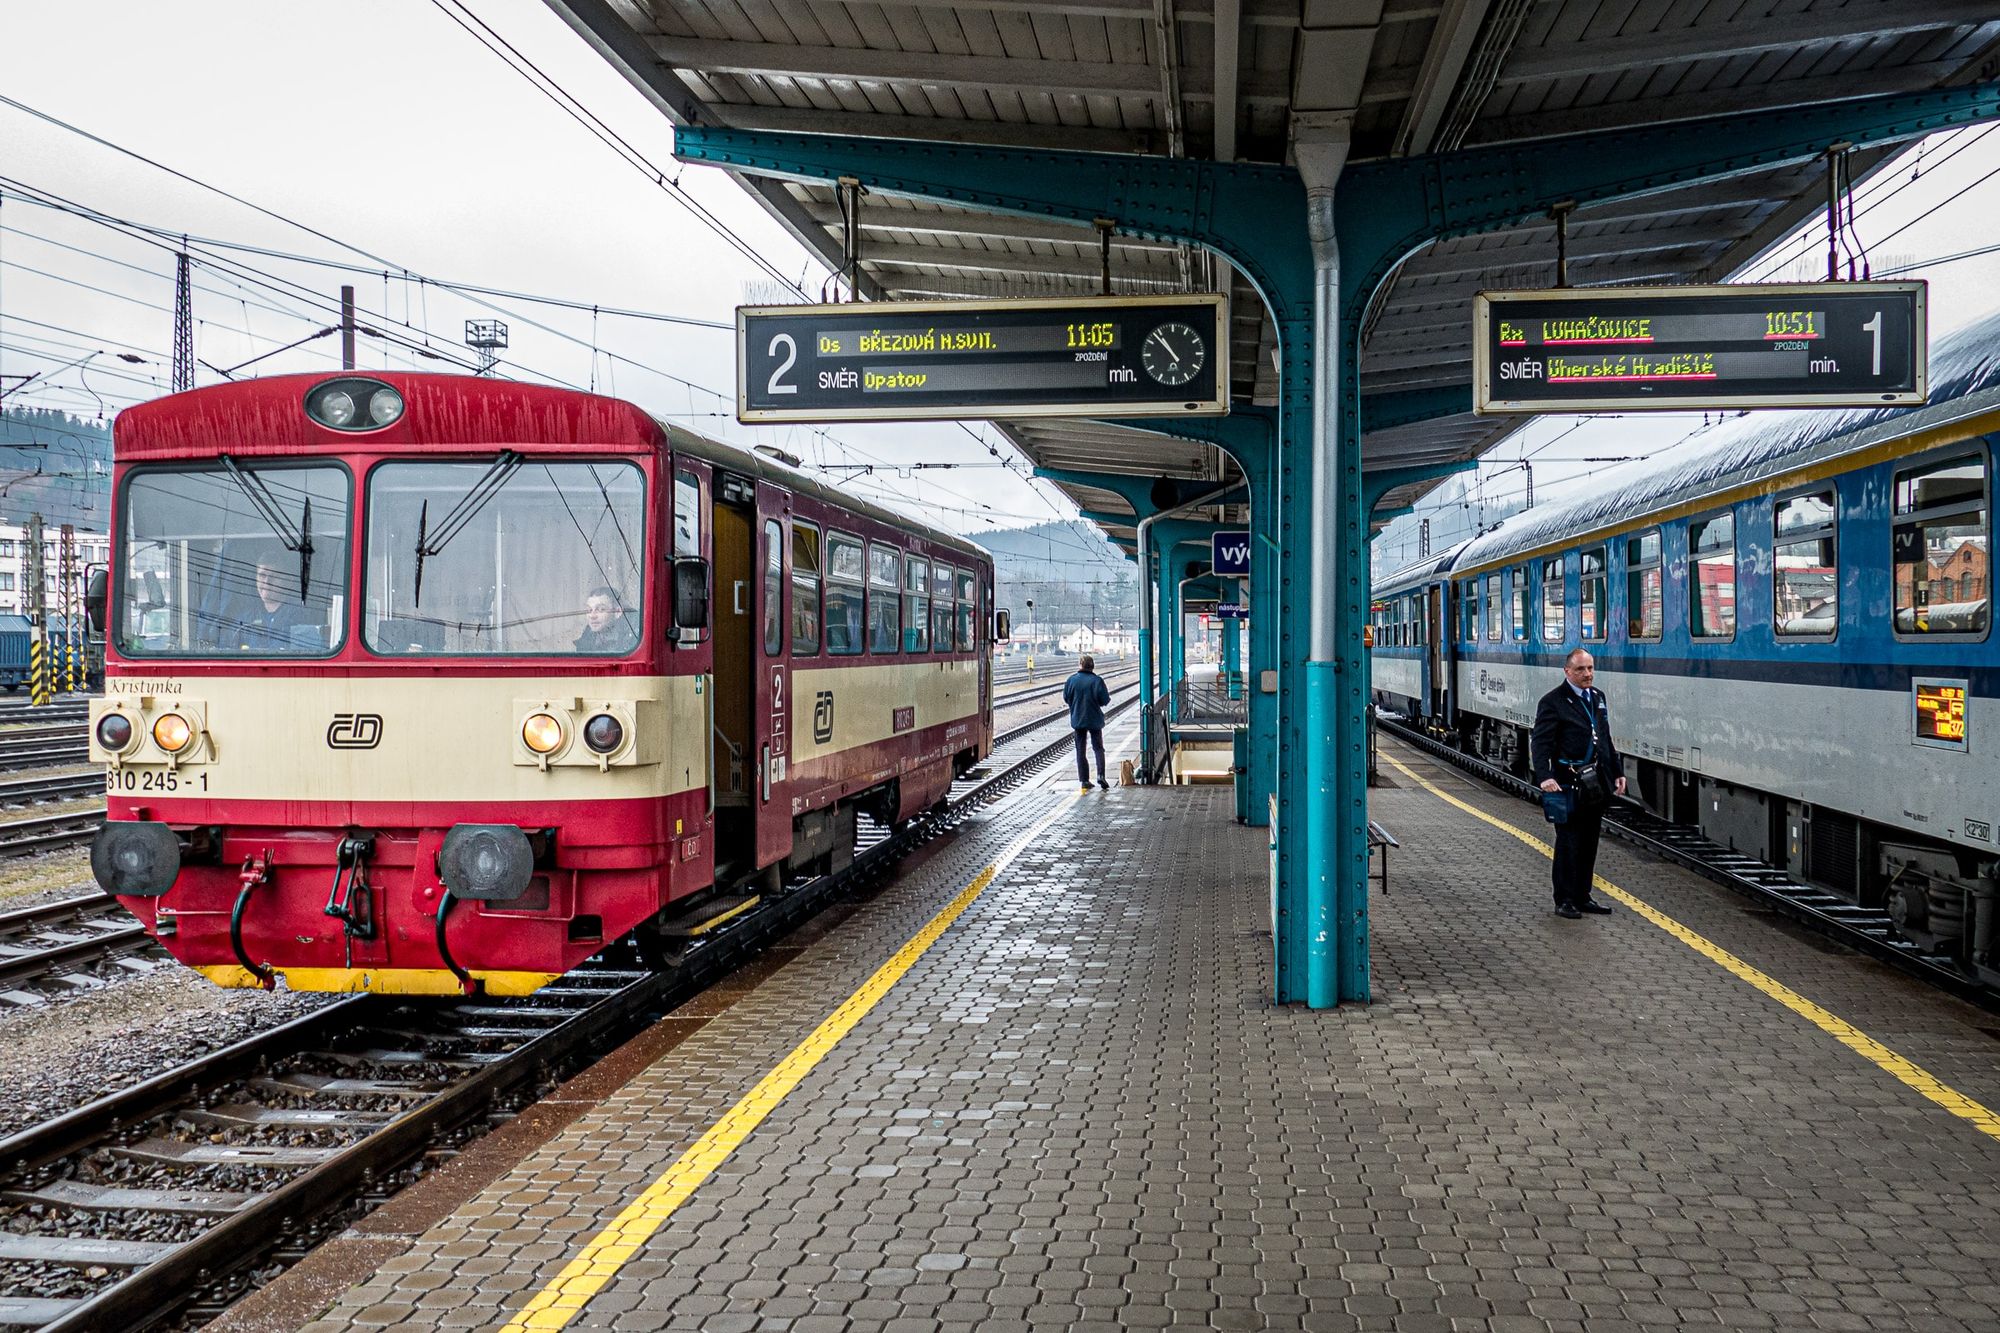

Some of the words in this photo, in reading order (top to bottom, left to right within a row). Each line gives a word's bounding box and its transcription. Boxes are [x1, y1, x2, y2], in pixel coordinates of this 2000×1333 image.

[1543, 316, 1651, 340] LUHAČOVICE
[1765, 311, 1816, 334] 10:51
[820, 336, 841, 353] Os
[859, 328, 935, 352] BŘEZOVÁ
[1067, 323, 1114, 347] 11:05
[1863, 311, 1882, 376] 1
[767, 333, 798, 394] 2
[1109, 365, 1137, 383] min.
[1500, 357, 1543, 380] SMĚR
[1548, 356, 1626, 377] Uherské
[1632, 353, 1713, 376] Hradiště
[1810, 356, 1840, 374] min.
[818, 367, 858, 389] SMĚR
[864, 372, 926, 390] Opatov
[109, 678, 183, 697] Kristýnka
[774, 674, 782, 708] 2
[107, 771, 136, 790] 810
[142, 771, 178, 791] 245
[200, 772, 208, 791] 1
[685, 767, 690, 786] 1
